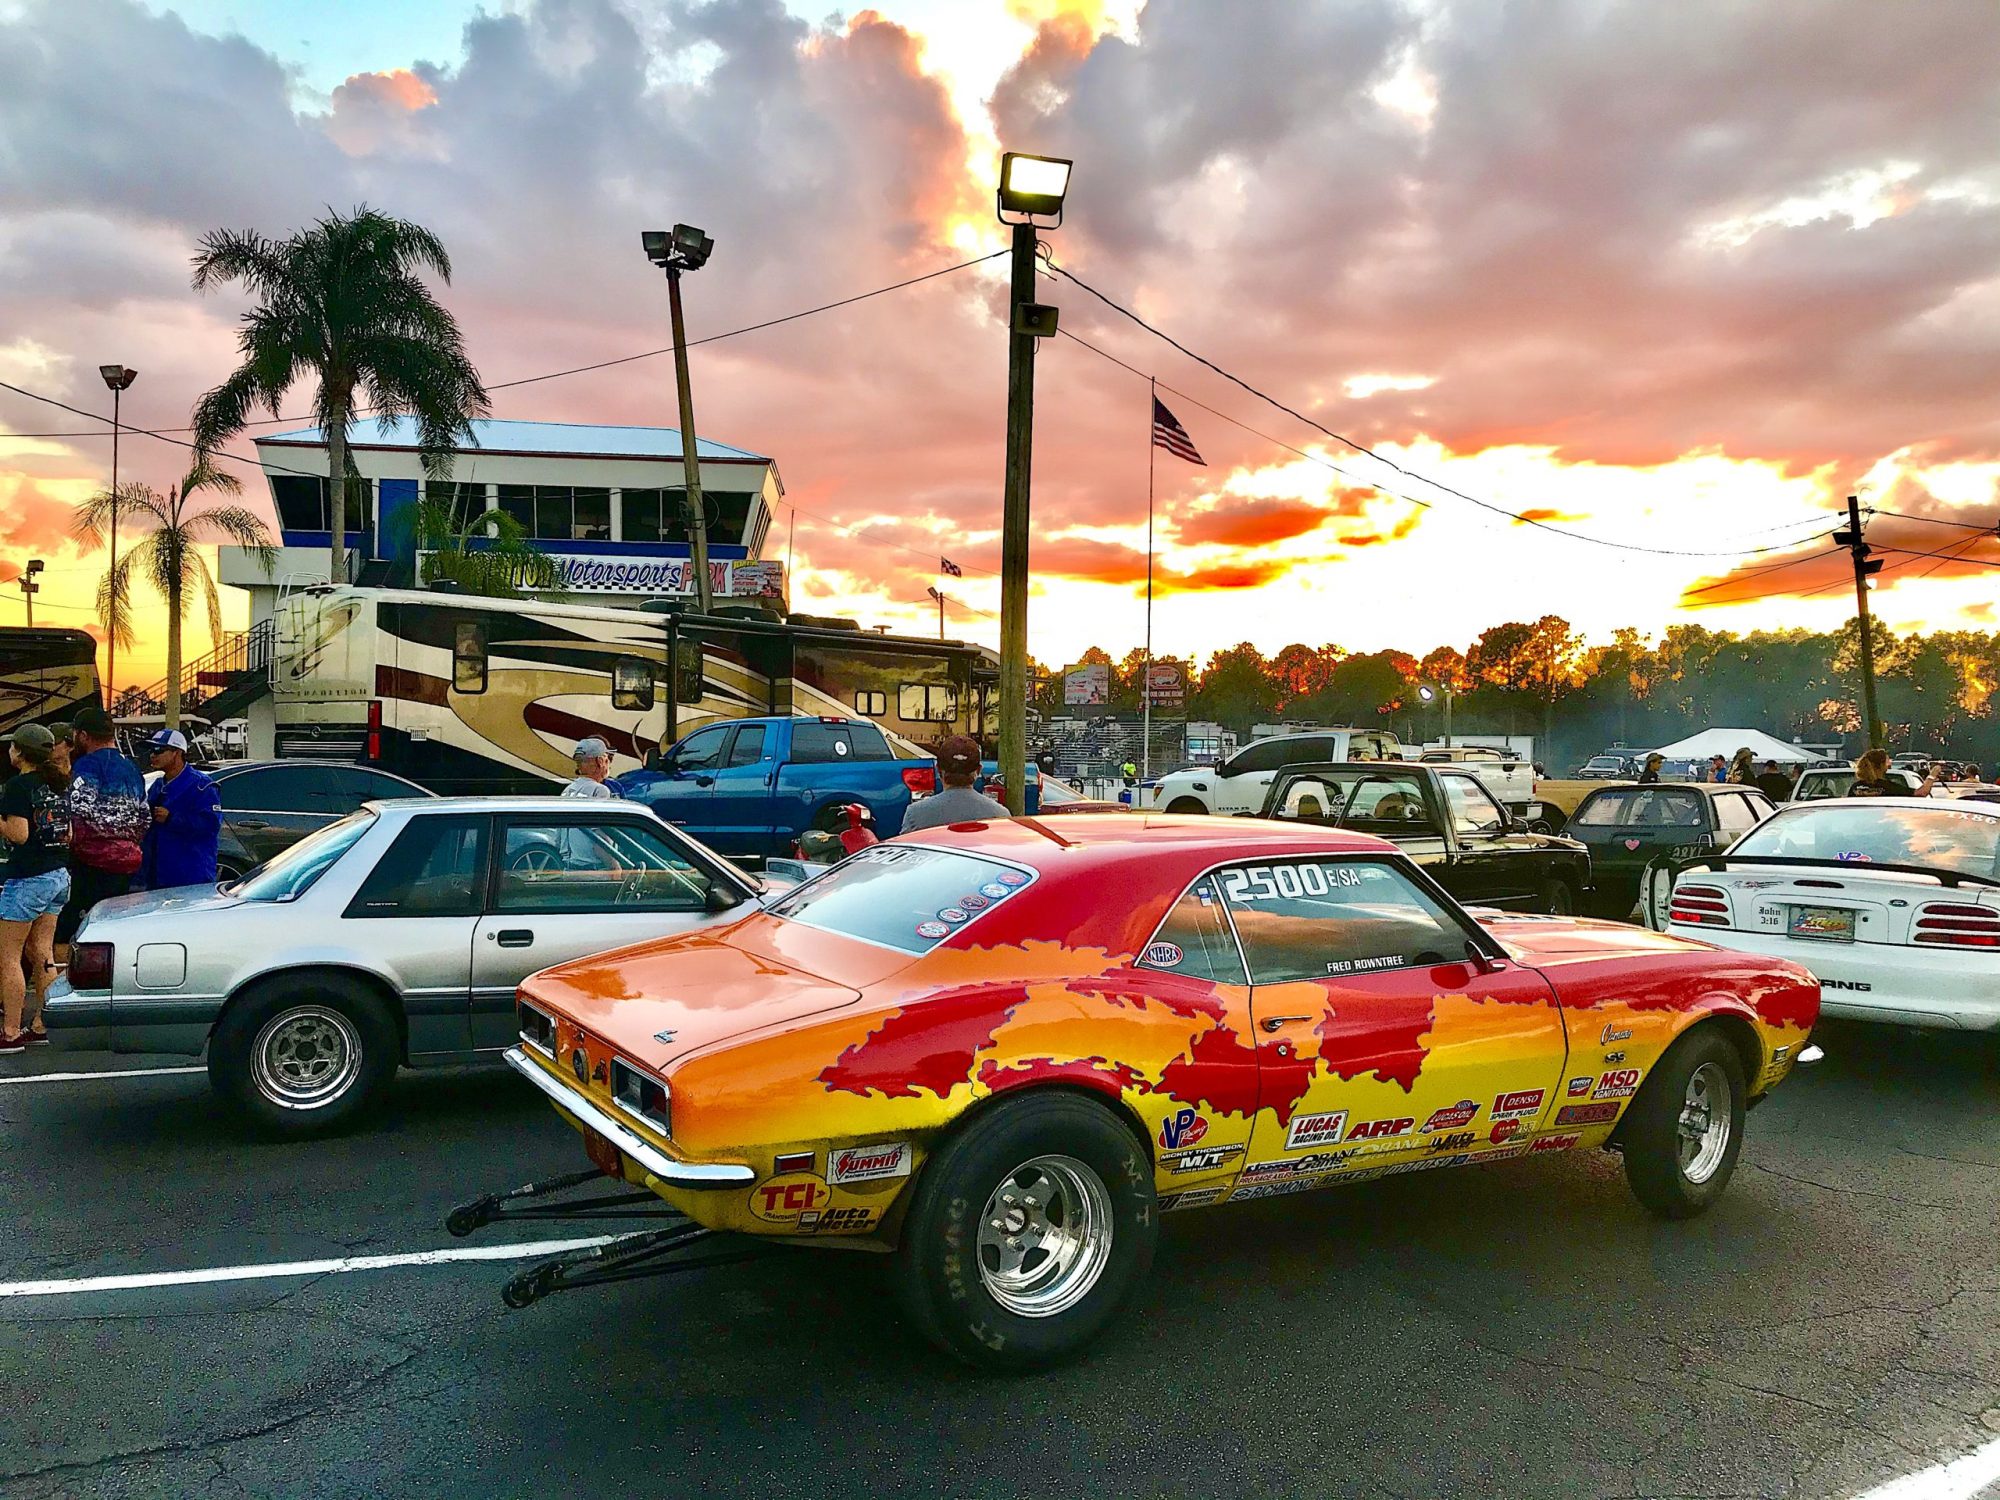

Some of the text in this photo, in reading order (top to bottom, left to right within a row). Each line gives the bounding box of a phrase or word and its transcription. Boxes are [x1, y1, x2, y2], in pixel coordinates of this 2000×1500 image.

[561, 559, 681, 587] Motorsports
[680, 562, 729, 593] PRK
[1838, 852, 1862, 861] VP
[1221, 863, 1361, 902] 2500 E/SA
[1758, 907, 1781, 917] John
[1760, 916, 1779, 926] 3:16
[1149, 947, 1178, 962] NHRA
[1326, 955, 1405, 973] FRED ROWNTREE
[1598, 1069, 1639, 1089] MSD
[1507, 1095, 1539, 1107] DENSO
[1594, 1088, 1632, 1099] IGNITION
[1490, 1107, 1539, 1121] SPARK PLUGS
[1162, 1108, 1196, 1150] VP
[1294, 1115, 1343, 1135] LUCAS
[1344, 1117, 1415, 1140] ARP
[1292, 1130, 1337, 1145] RACING OIL
[1160, 1150, 1194, 1160] MICKEY
[1195, 1143, 1244, 1154] THOMPSON
[1180, 1152, 1225, 1169] M/T
[1250, 1177, 1316, 1198] RICHMOND
[760, 1183, 817, 1212] TCI
[823, 1207, 871, 1220] Auto
[818, 1218, 877, 1231] Meter
